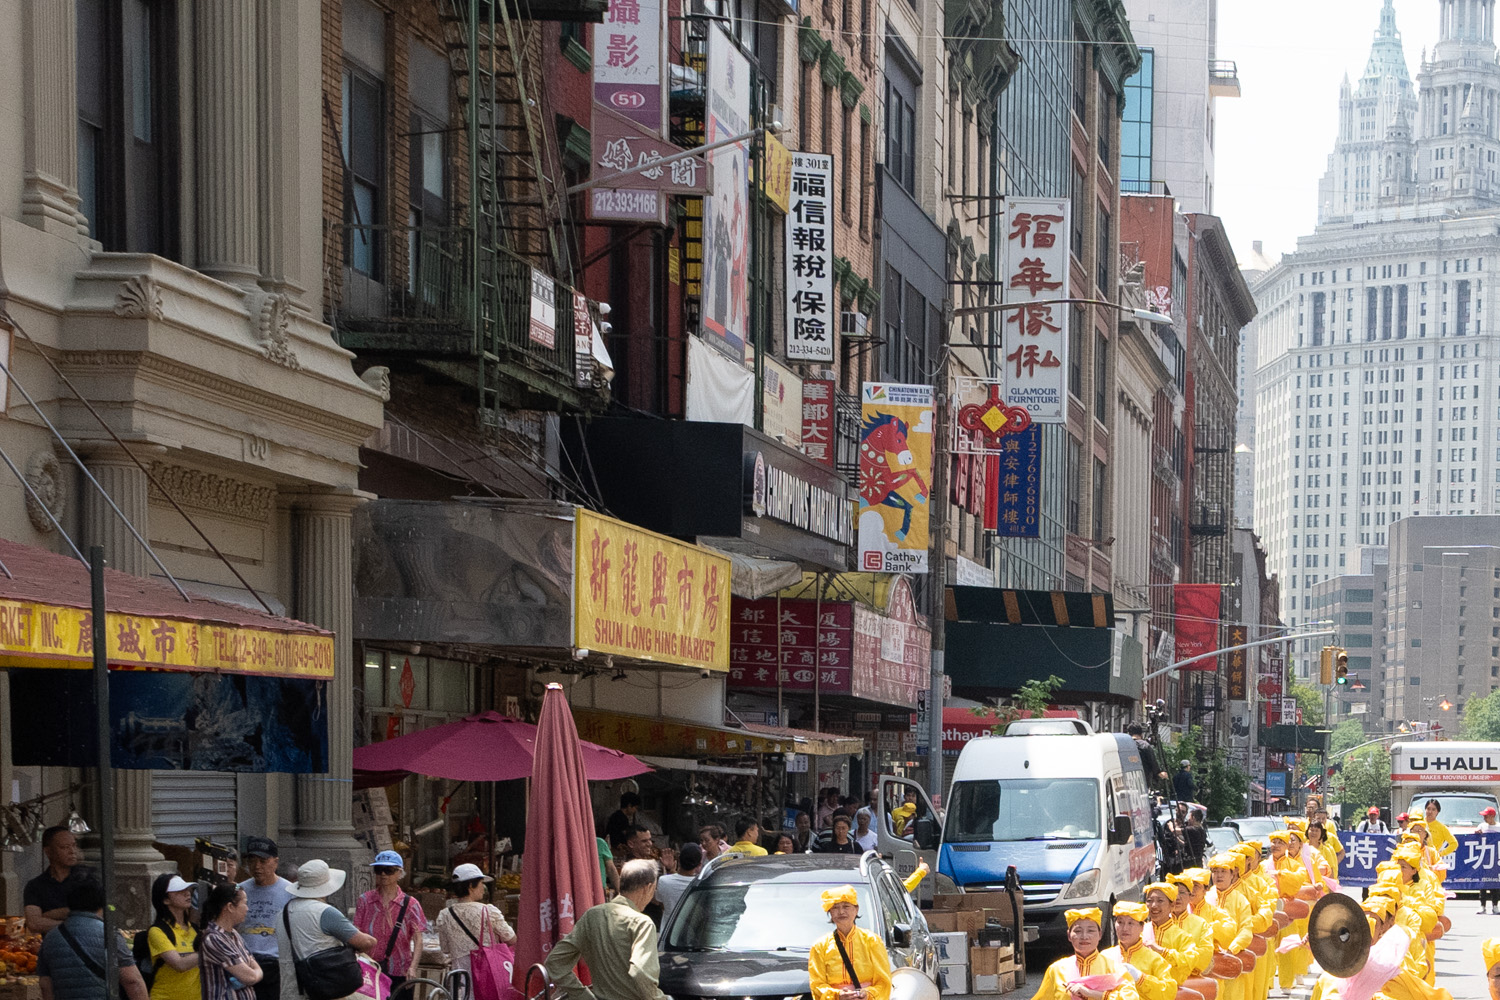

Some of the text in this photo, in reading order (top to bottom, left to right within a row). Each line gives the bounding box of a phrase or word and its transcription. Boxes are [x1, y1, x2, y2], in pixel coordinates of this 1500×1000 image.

[606, 0, 640, 68] 攝影
[618, 94, 638, 106] 51
[595, 192, 657, 214] 212-393-1166
[789, 344, 831, 356] 212-334-5420
[1011, 388, 1057, 396] GLAMOUR
[1008, 396, 1060, 404] FURNITURE
[802, 383, 829, 460] 華都大廈
[885, 552, 922, 564] Cathay
[885, 562, 912, 572] Bank
[590, 528, 720, 633] 新龍興市場
[41, 611, 63, 649] INC.
[594, 618, 715, 662] SHUN LONG HING MARKET
[942, 729, 978, 742] athay
[1410, 757, 1498, 771] U-HAUL
